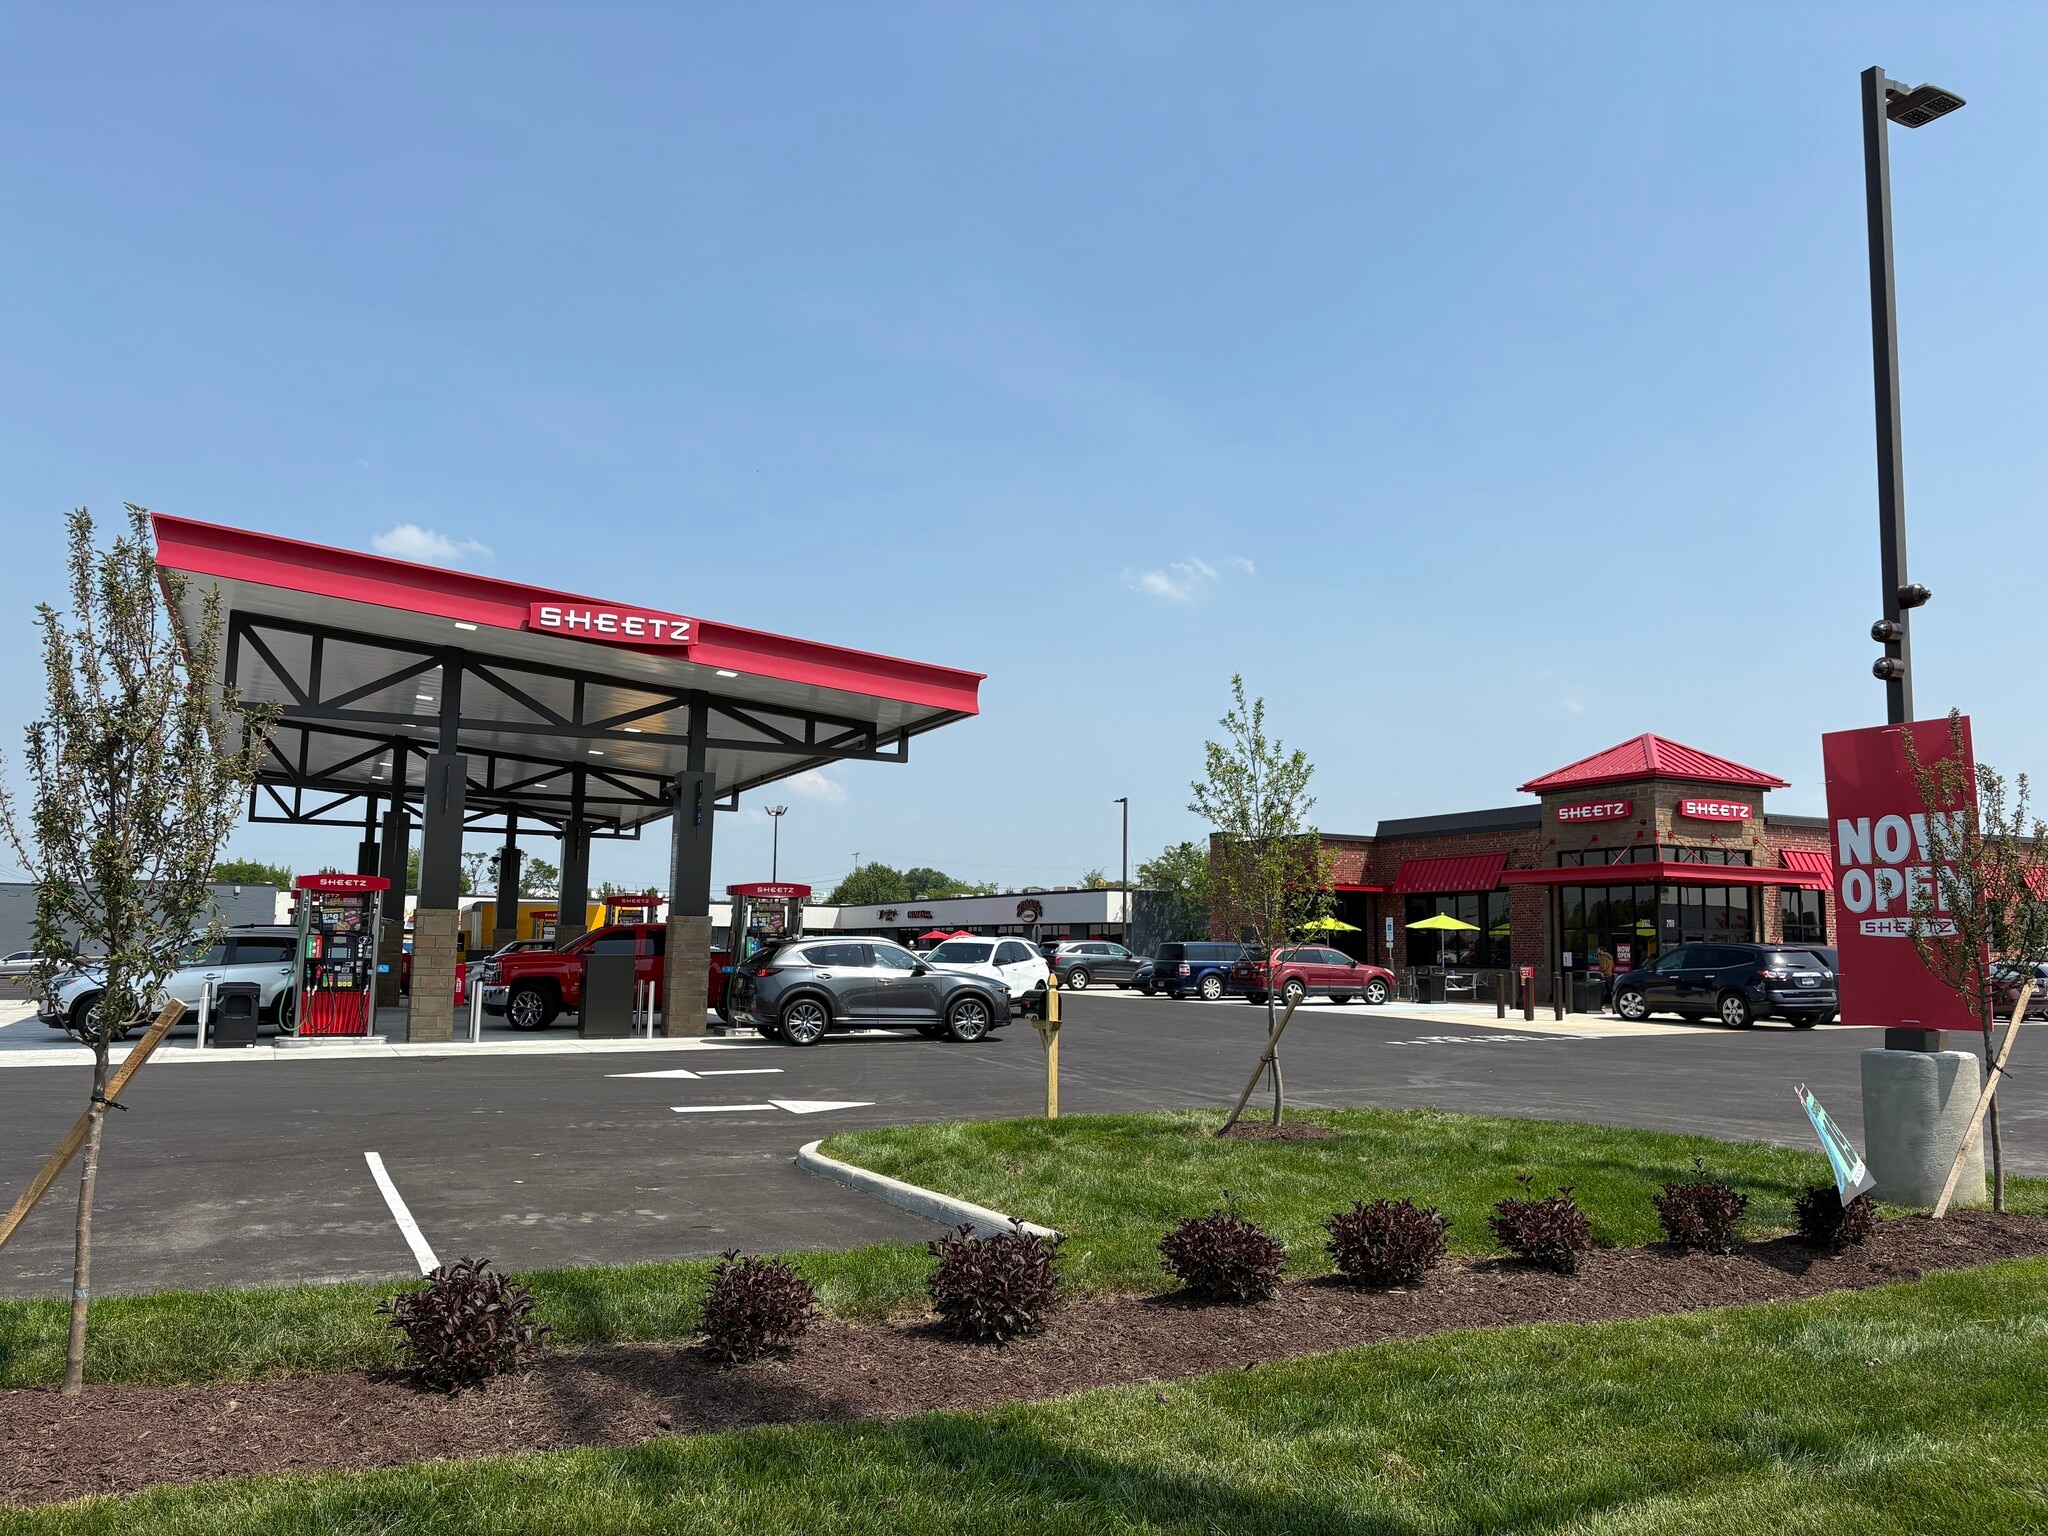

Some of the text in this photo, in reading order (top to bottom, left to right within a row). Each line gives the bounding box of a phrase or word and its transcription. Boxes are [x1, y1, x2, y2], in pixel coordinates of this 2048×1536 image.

[540, 607, 690, 641] SHEETZ
[1558, 802, 1625, 820] SHEETZ
[1686, 801, 1749, 818] SHEETZ
[1837, 810, 1968, 866] NOW
[319, 878, 367, 887] SHEETZ
[1865, 921, 1952, 933] SHETZ
